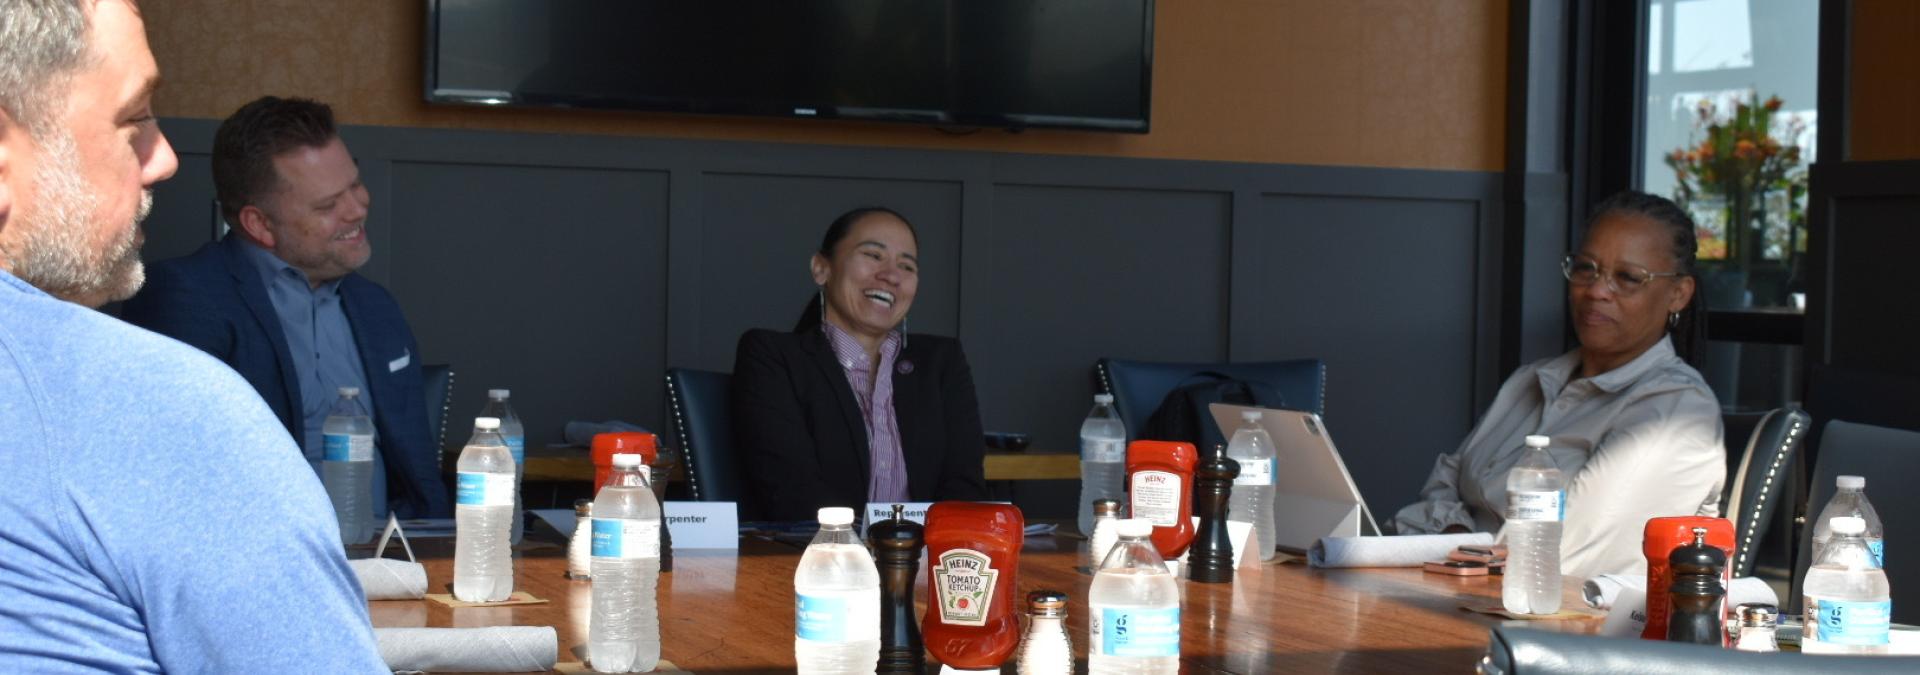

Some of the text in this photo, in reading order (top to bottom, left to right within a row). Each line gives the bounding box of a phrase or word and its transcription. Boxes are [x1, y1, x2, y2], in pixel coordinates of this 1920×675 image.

[1144, 475, 1167, 484] HEINZ
[948, 559, 979, 570] HEINZ
[946, 574, 981, 585] TOMATO
[948, 584, 979, 593] KETCHUP
